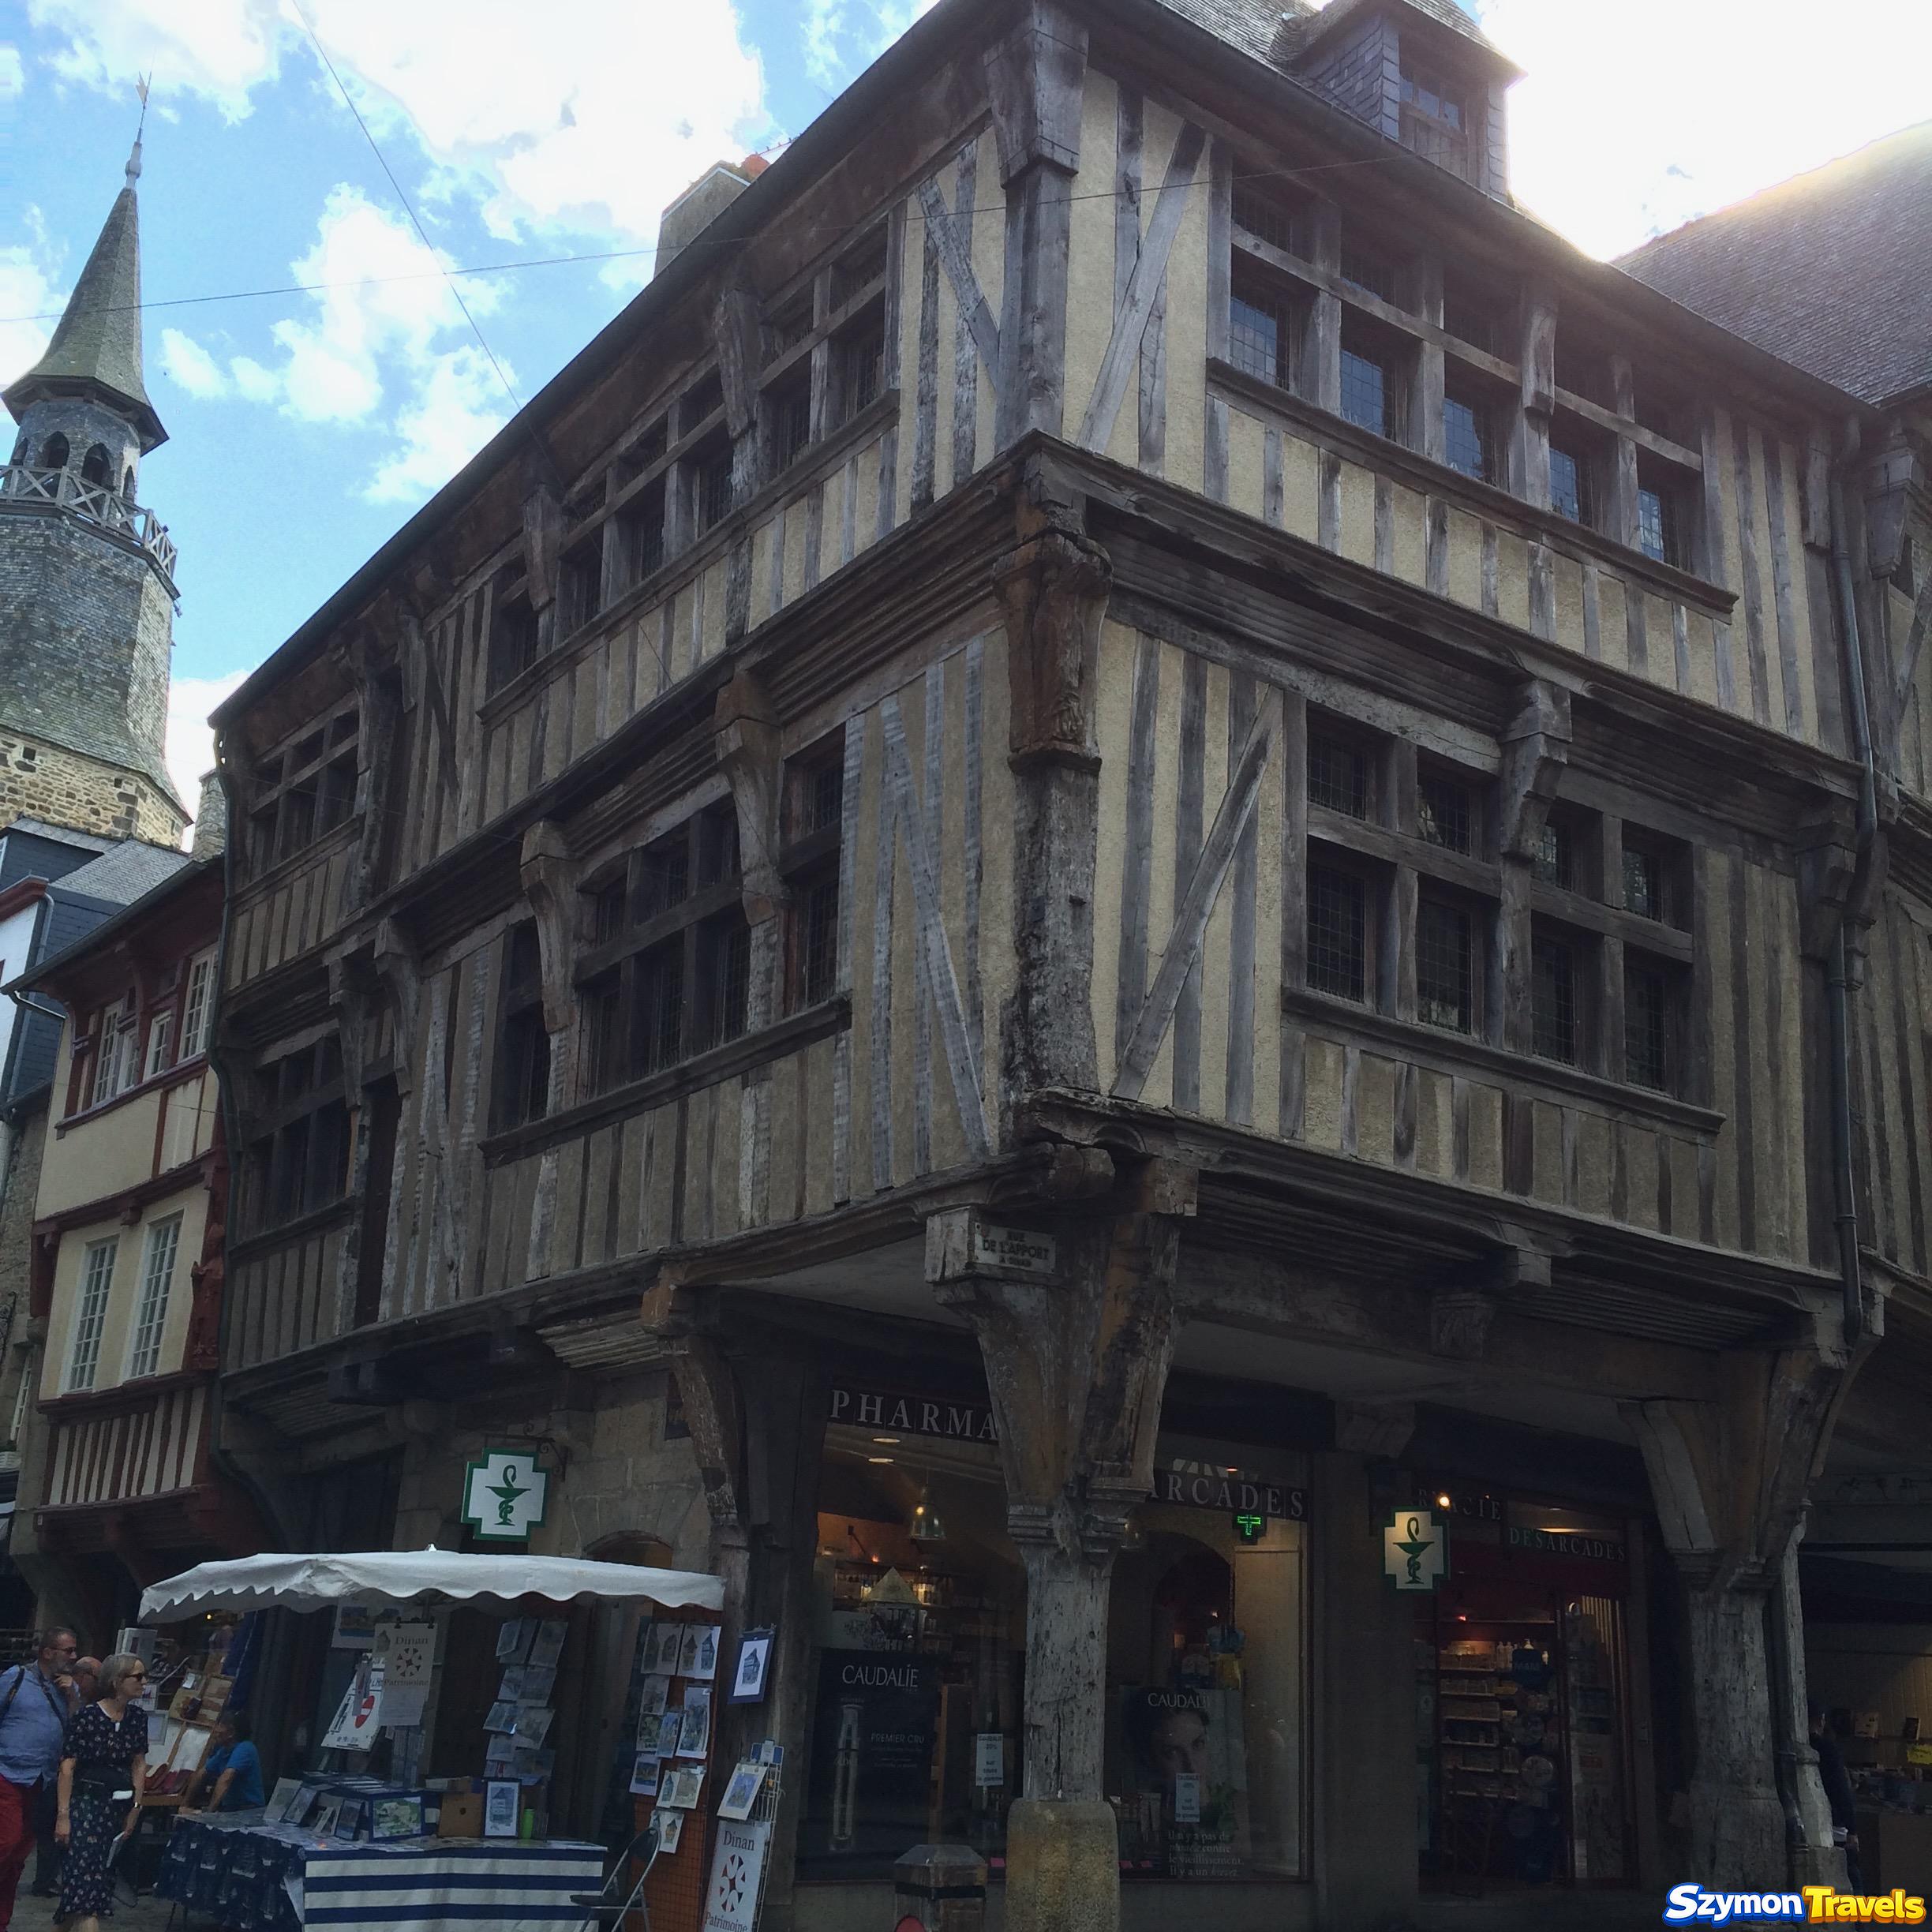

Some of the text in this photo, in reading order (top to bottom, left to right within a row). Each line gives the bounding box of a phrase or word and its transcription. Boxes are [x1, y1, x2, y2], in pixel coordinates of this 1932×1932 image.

[983, 1239, 997, 1253] DE
[829, 1389, 998, 1440] PHARMA
[1546, 1533, 1626, 1562] ARCADES
[395, 1636, 429, 1645] Dinan
[723, 1830, 754, 1851] Dinan
[706, 1911, 748, 1932] Patrimoine
